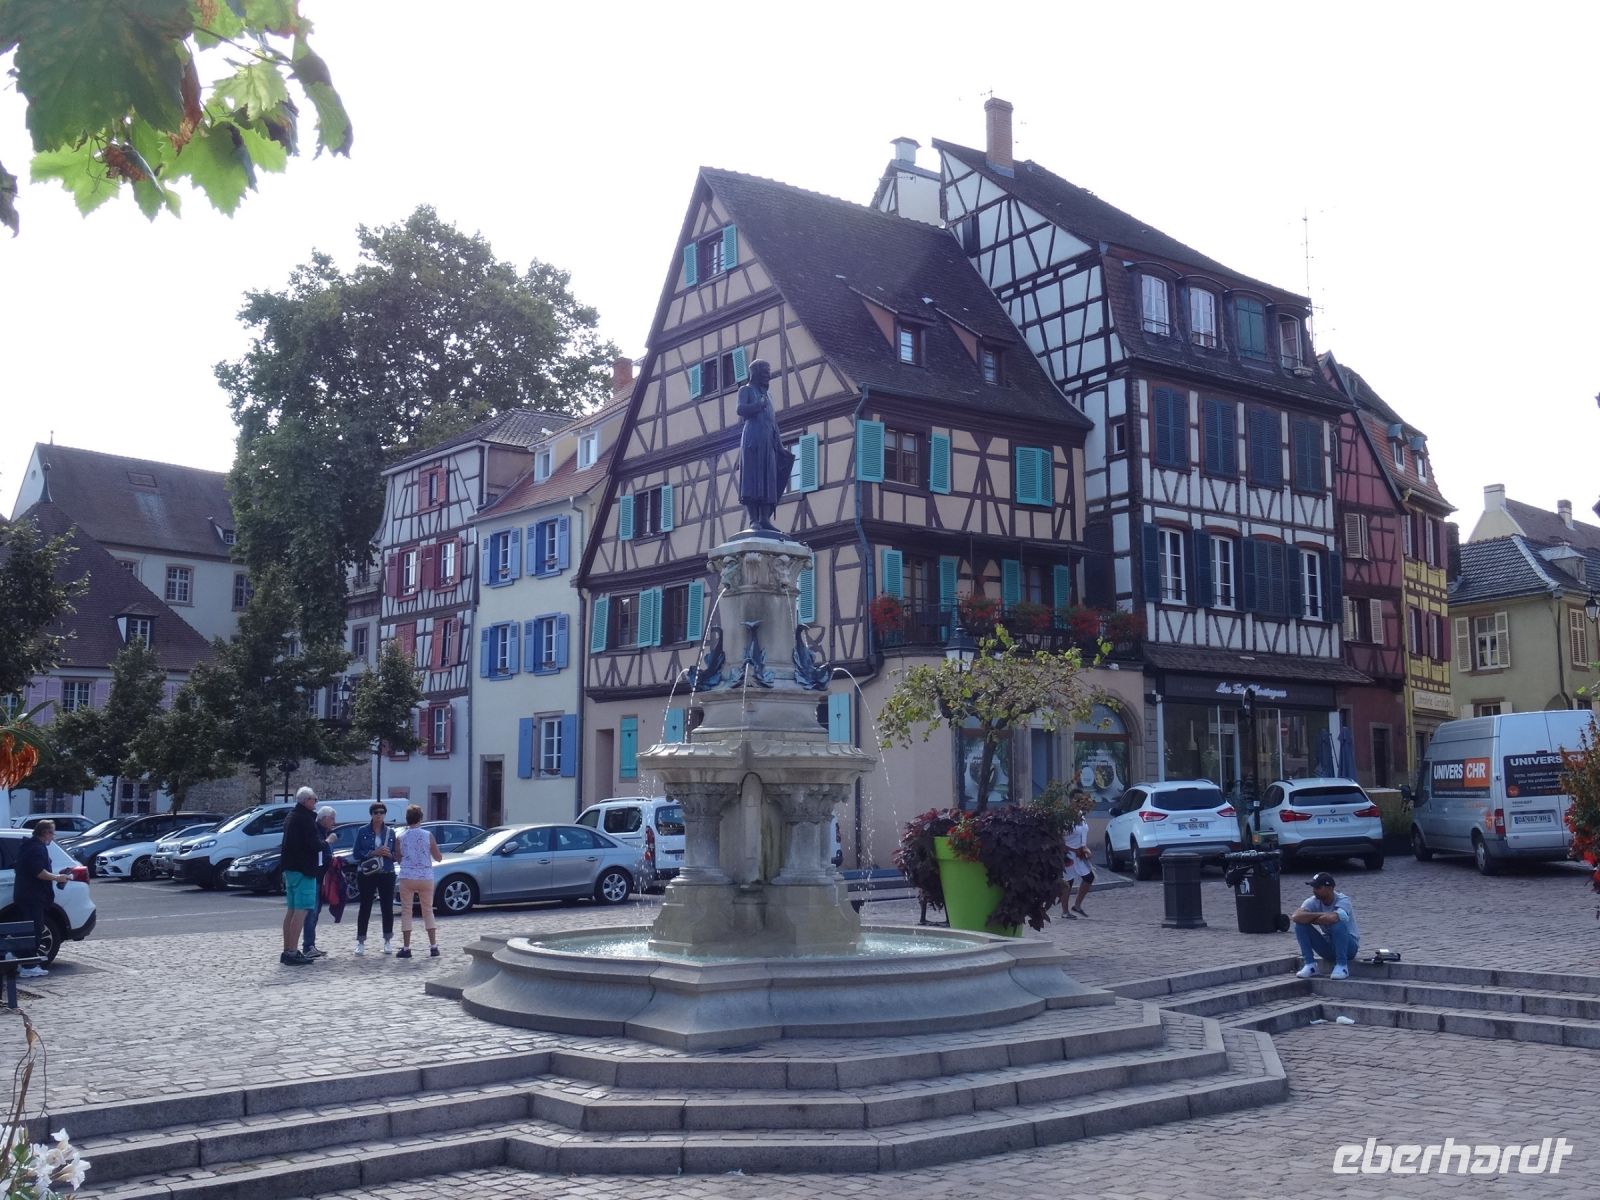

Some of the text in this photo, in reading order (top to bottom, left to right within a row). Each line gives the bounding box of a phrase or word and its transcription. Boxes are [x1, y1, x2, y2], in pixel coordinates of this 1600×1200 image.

[1510, 755, 1563, 767] UNIVERS
[1433, 762, 1486, 780] UNIVERS CHR
